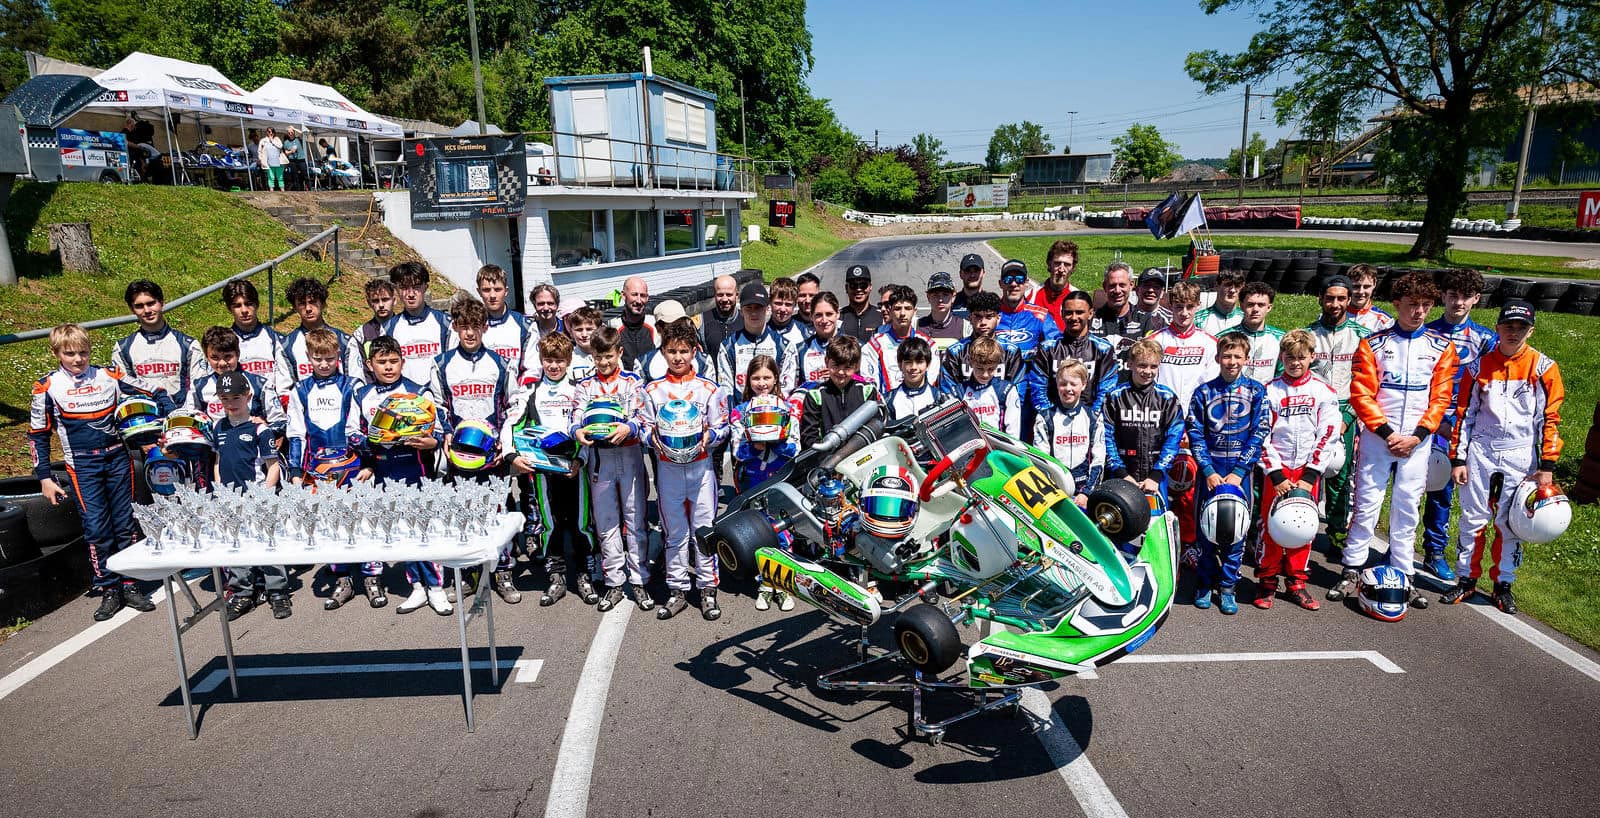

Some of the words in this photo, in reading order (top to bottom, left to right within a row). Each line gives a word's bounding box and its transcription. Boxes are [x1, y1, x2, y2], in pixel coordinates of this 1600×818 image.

[400, 343, 440, 357] SPIRIT
[136, 363, 179, 376] SPIRIT
[239, 360, 275, 374] PIRIT
[452, 383, 495, 397] SPIRIT
[316, 397, 335, 406] IWC
[1056, 435, 1087, 445] SPIRIT
[762, 559, 793, 594] 444
[1066, 559, 1093, 582] HASLER
